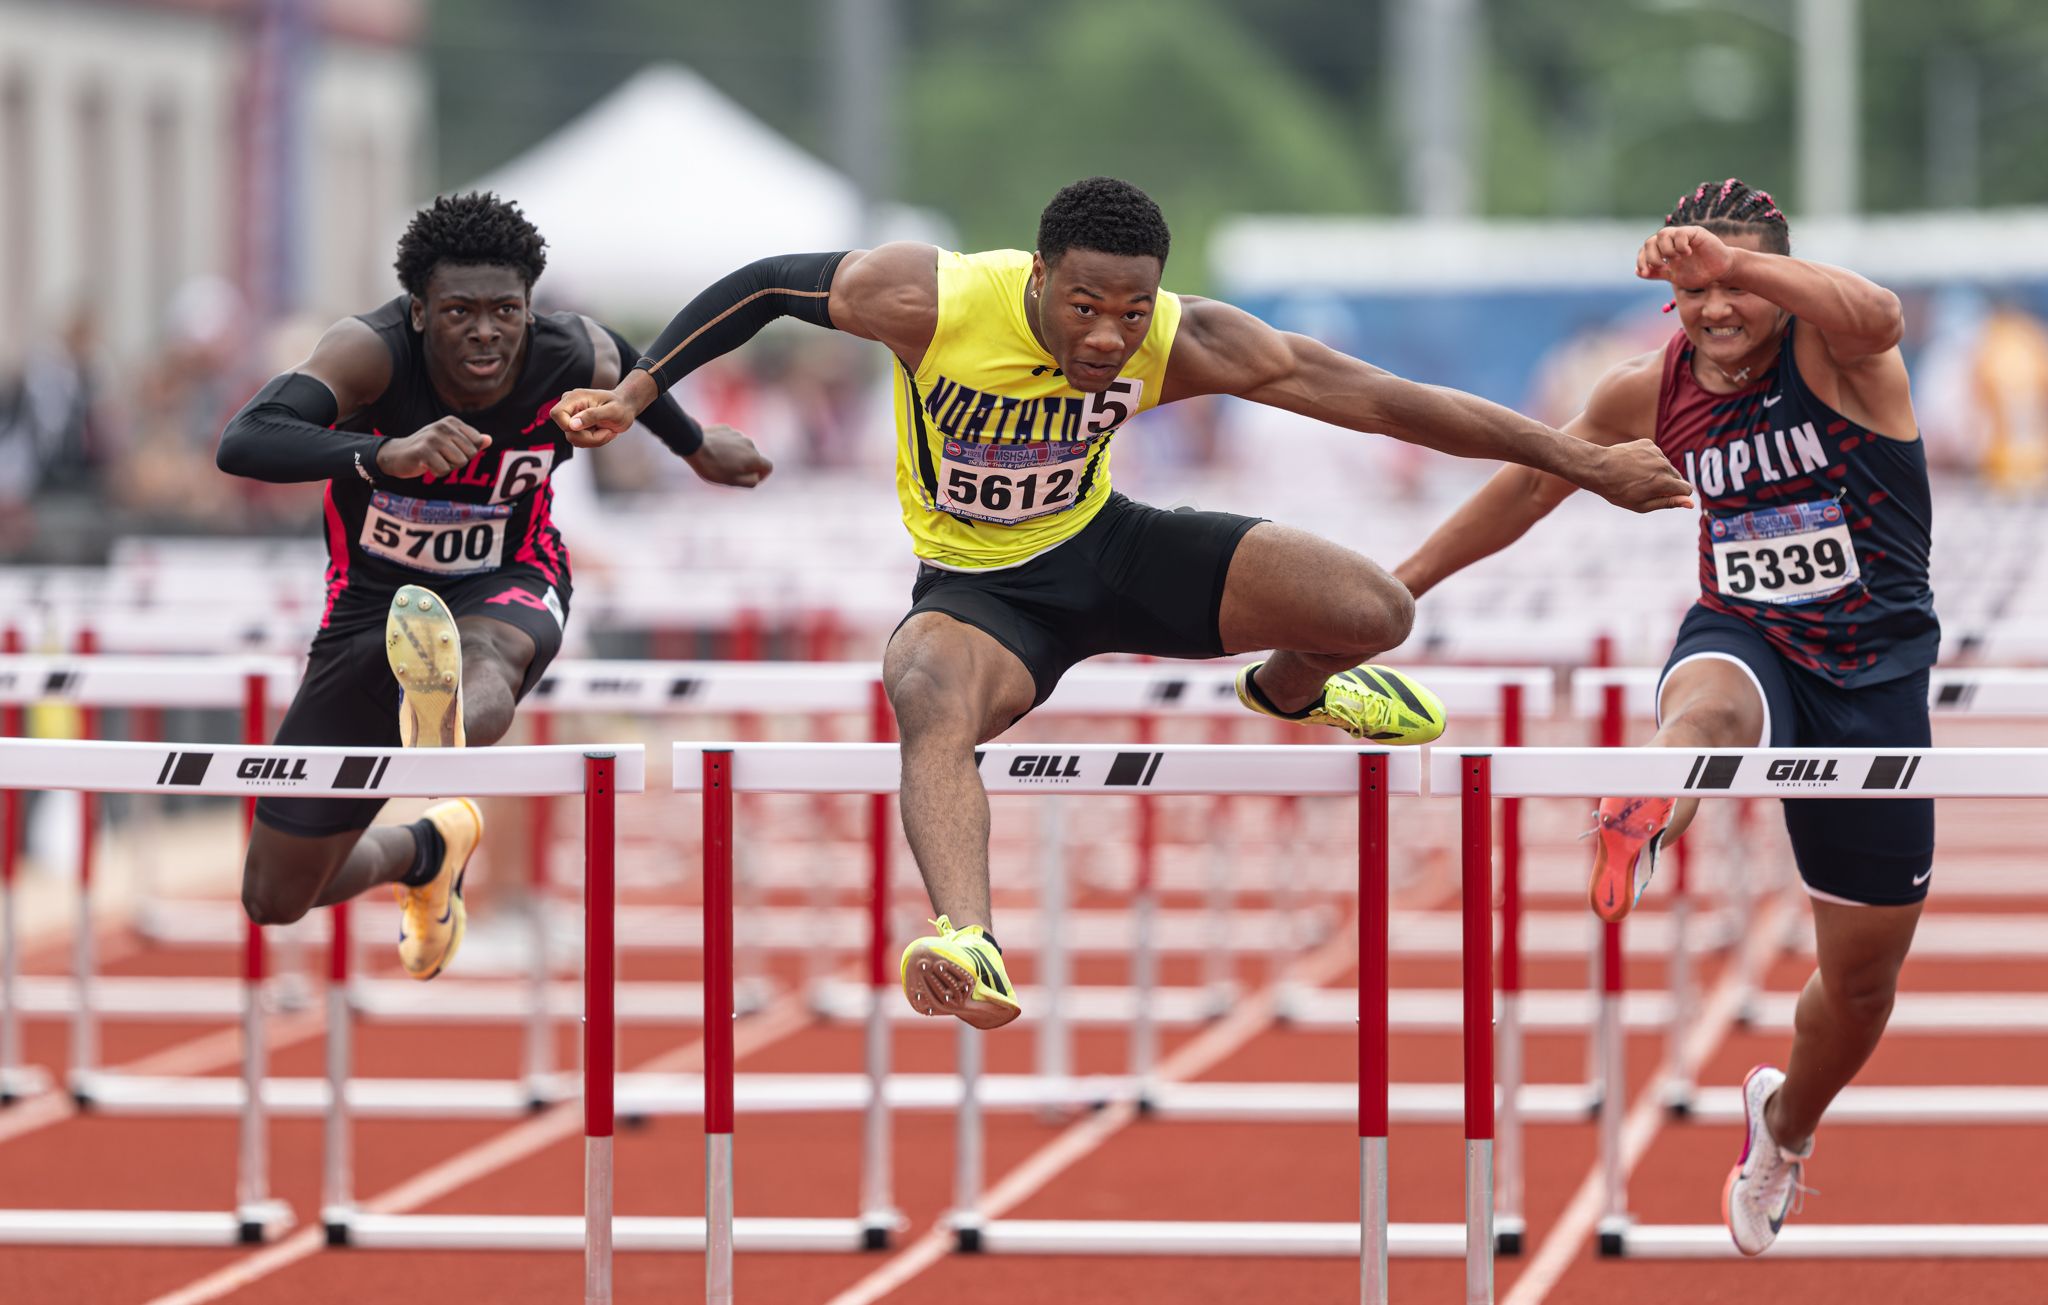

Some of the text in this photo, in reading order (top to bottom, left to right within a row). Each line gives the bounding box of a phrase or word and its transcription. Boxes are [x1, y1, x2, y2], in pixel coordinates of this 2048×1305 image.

[1087, 381, 1132, 434] 5
[995, 449, 1038, 461] MSHSAA
[500, 456, 542, 499] 6
[947, 468, 1074, 511] 5612
[373, 516, 494, 564] 5700
[1725, 537, 1847, 594] 5339
[236, 757, 308, 779] GILL
[1009, 755, 1081, 777] GILL
[1766, 759, 1839, 781] GILL
